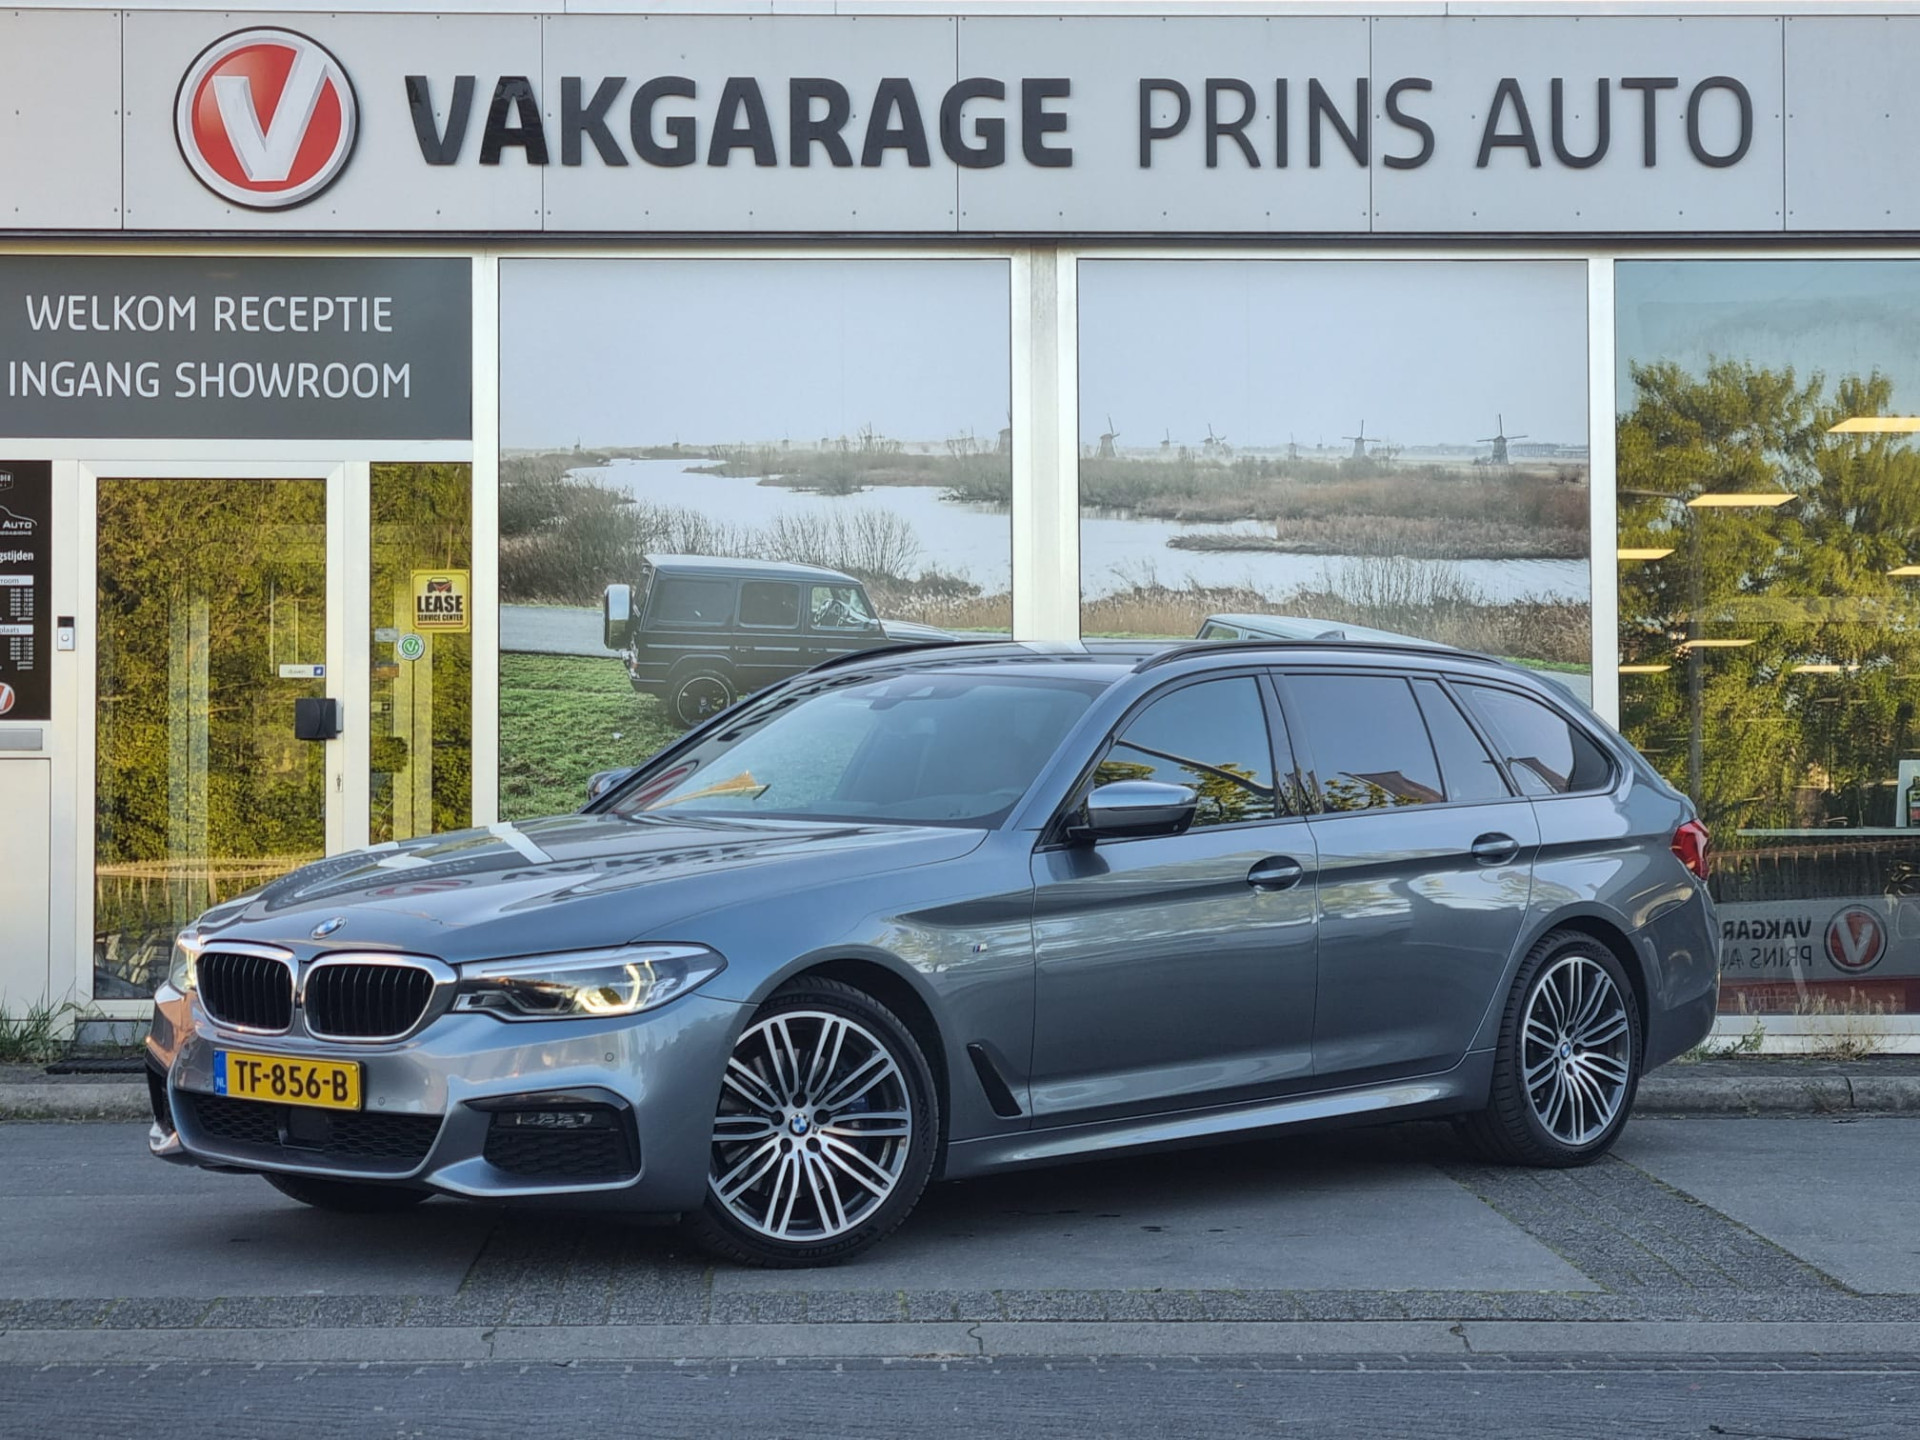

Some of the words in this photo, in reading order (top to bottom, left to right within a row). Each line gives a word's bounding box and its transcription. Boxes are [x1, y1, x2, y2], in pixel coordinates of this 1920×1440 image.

[405, 75, 1073, 169] VAKGARAGE
[1140, 78, 1434, 169] PRINS
[1477, 77, 1753, 169] AUTO
[26, 295, 196, 332] WELKOM
[214, 296, 393, 332] RECEPTIE
[8, 361, 160, 398] INGANG
[175, 361, 411, 399] SHOWROOM
[2, 520, 32, 529] AUTO
[417, 595, 463, 612] LEASE
[417, 614, 441, 622] SERVICE
[234, 1060, 348, 1101] TF-856-B
